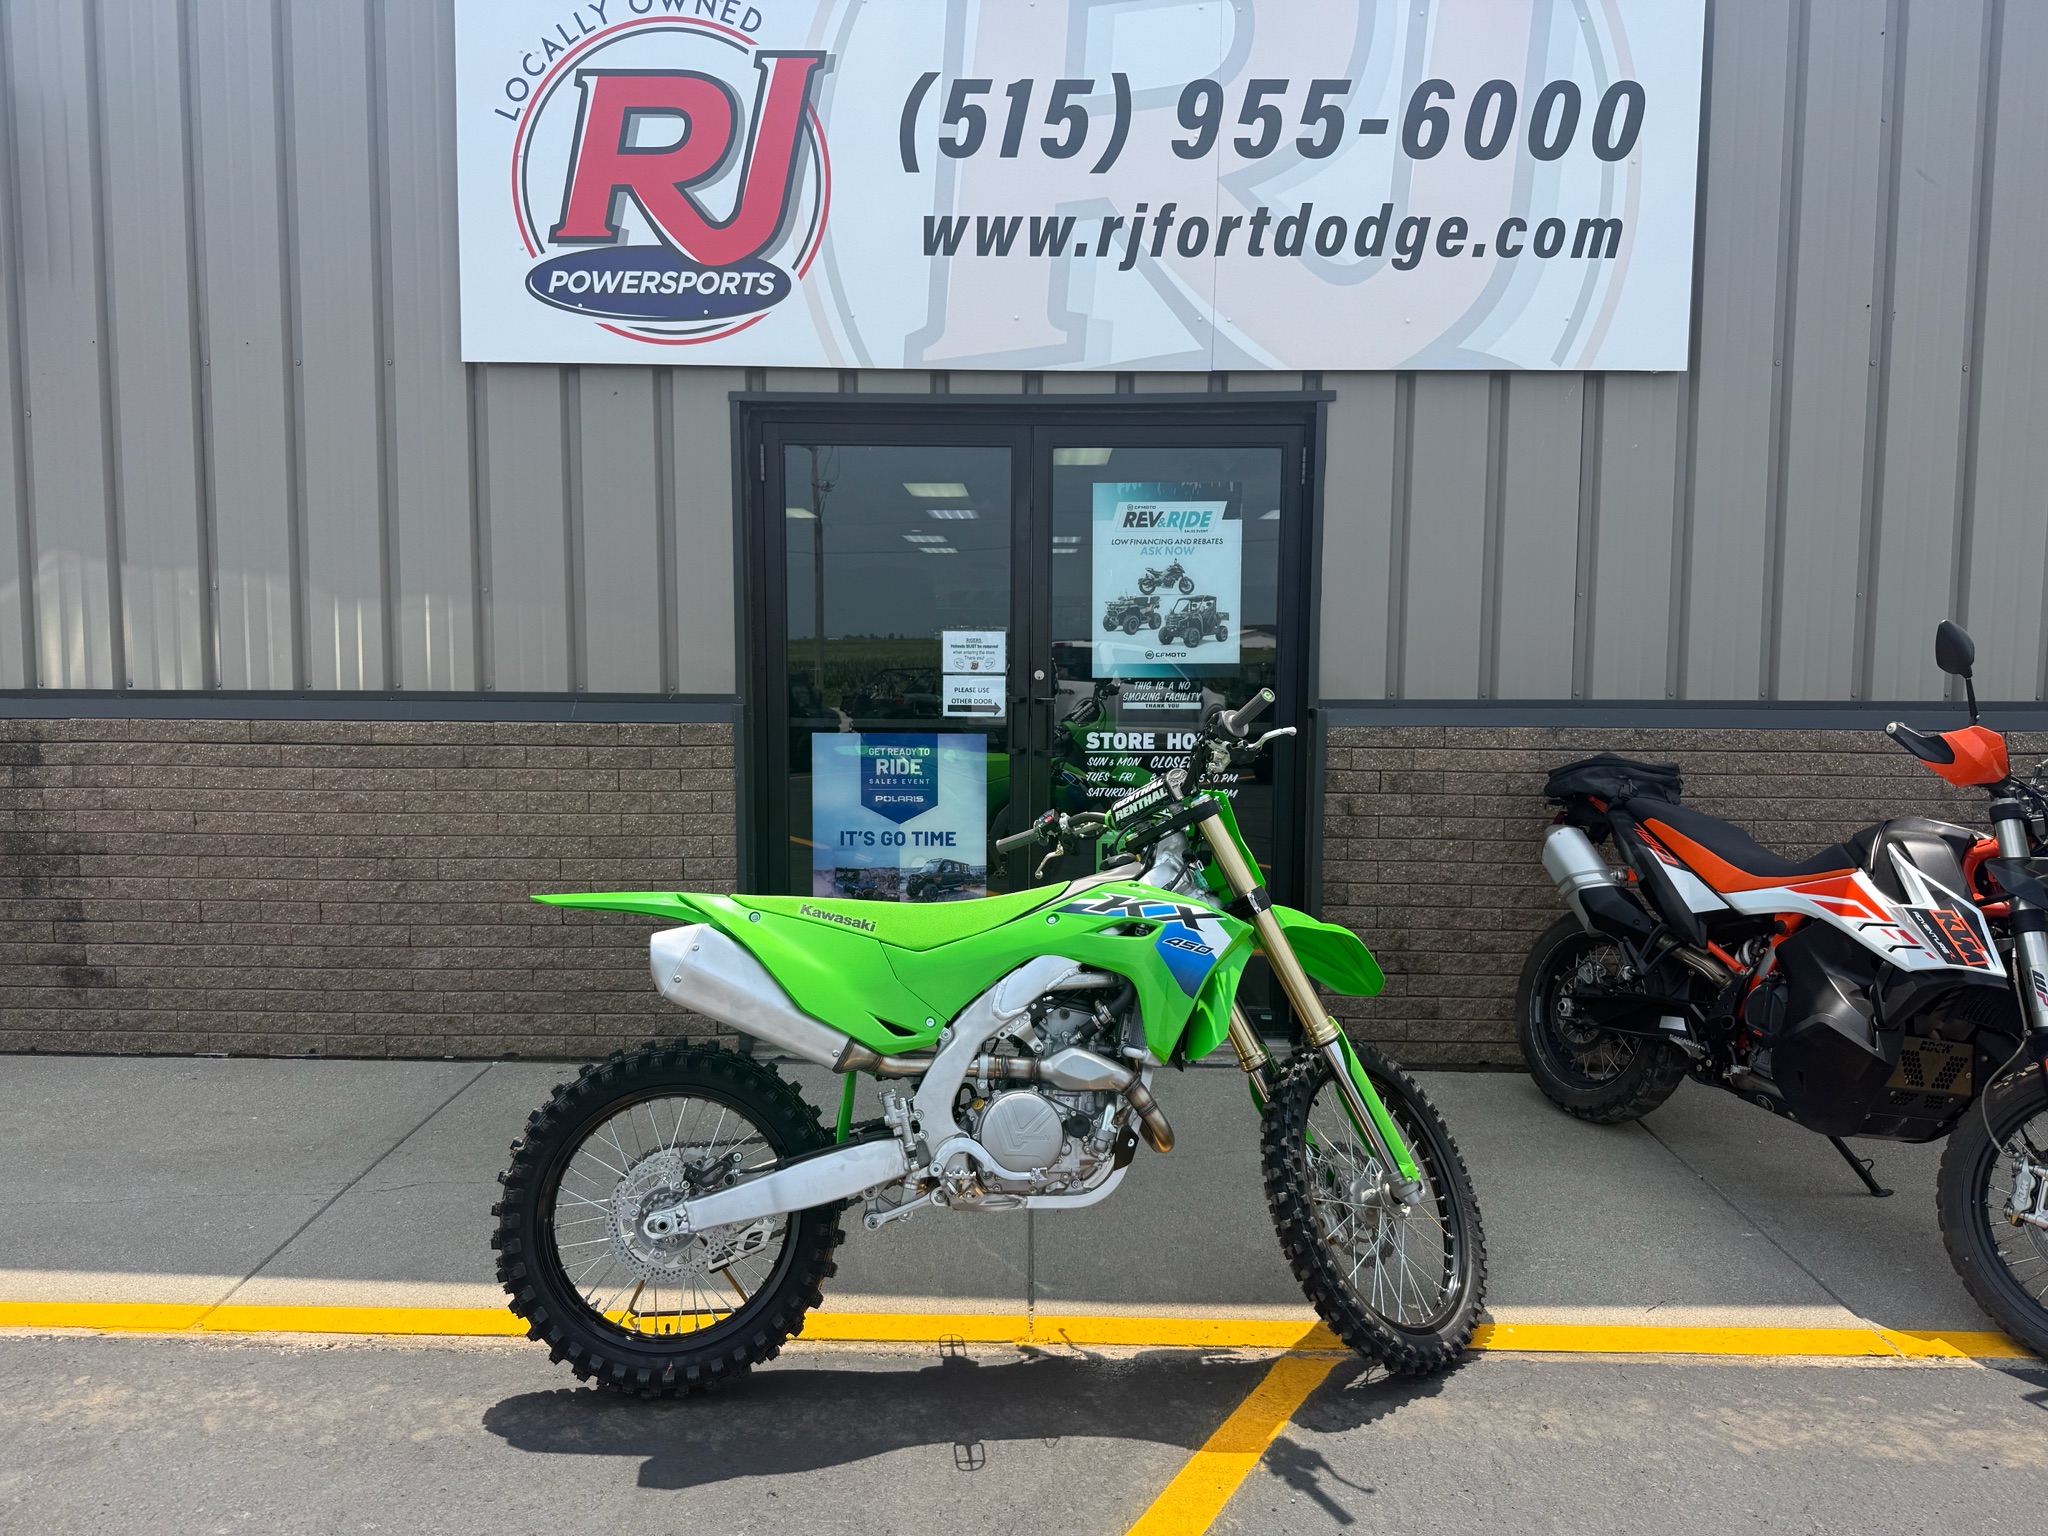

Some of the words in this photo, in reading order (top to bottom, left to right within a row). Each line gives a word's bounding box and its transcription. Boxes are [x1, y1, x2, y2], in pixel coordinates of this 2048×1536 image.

[494, 3, 608, 121] LOCALLY
[899, 71, 1132, 174] (515)
[1170, 78, 1646, 163] 955-6000
[548, 50, 832, 267] RJ
[922, 202, 1623, 271] www.rjfortdodge.com
[547, 270, 776, 296] POWERSPORTS
[1140, 547, 1162, 555] ASK
[1164, 546, 1195, 555] NOW
[1122, 692, 1160, 701] SMOKING
[1164, 692, 1202, 701] FACILITY
[1134, 681, 1152, 690] THIS
[1155, 681, 1165, 690] IS
[1168, 681, 1174, 690] A
[1178, 681, 1191, 690] NO
[868, 747, 885, 756] GET
[887, 747, 916, 756] READY
[918, 747, 930, 756] TO
[1086, 732, 1155, 749] STORE
[1167, 733, 1200, 749] HO
[876, 758, 923, 775] RIDE
[1087, 757, 1109, 766] SUN
[1116, 757, 1142, 766] MON
[1150, 755, 1190, 769] CLOSE
[1086, 772, 1110, 781] TUES
[1118, 772, 1136, 782] FRI
[1221, 774, 1239, 783] PM
[1115, 788, 1168, 821] RENTHAL
[840, 831, 875, 847] IT'S
[881, 831, 906, 847] GO
[911, 831, 957, 846] TIME
[800, 903, 877, 932] Kawasaki
[1083, 892, 1227, 933] KX
[1912, 911, 1950, 955] ADVENTURE
[1930, 909, 1989, 965] KTM
[1162, 937, 1214, 956] 450
